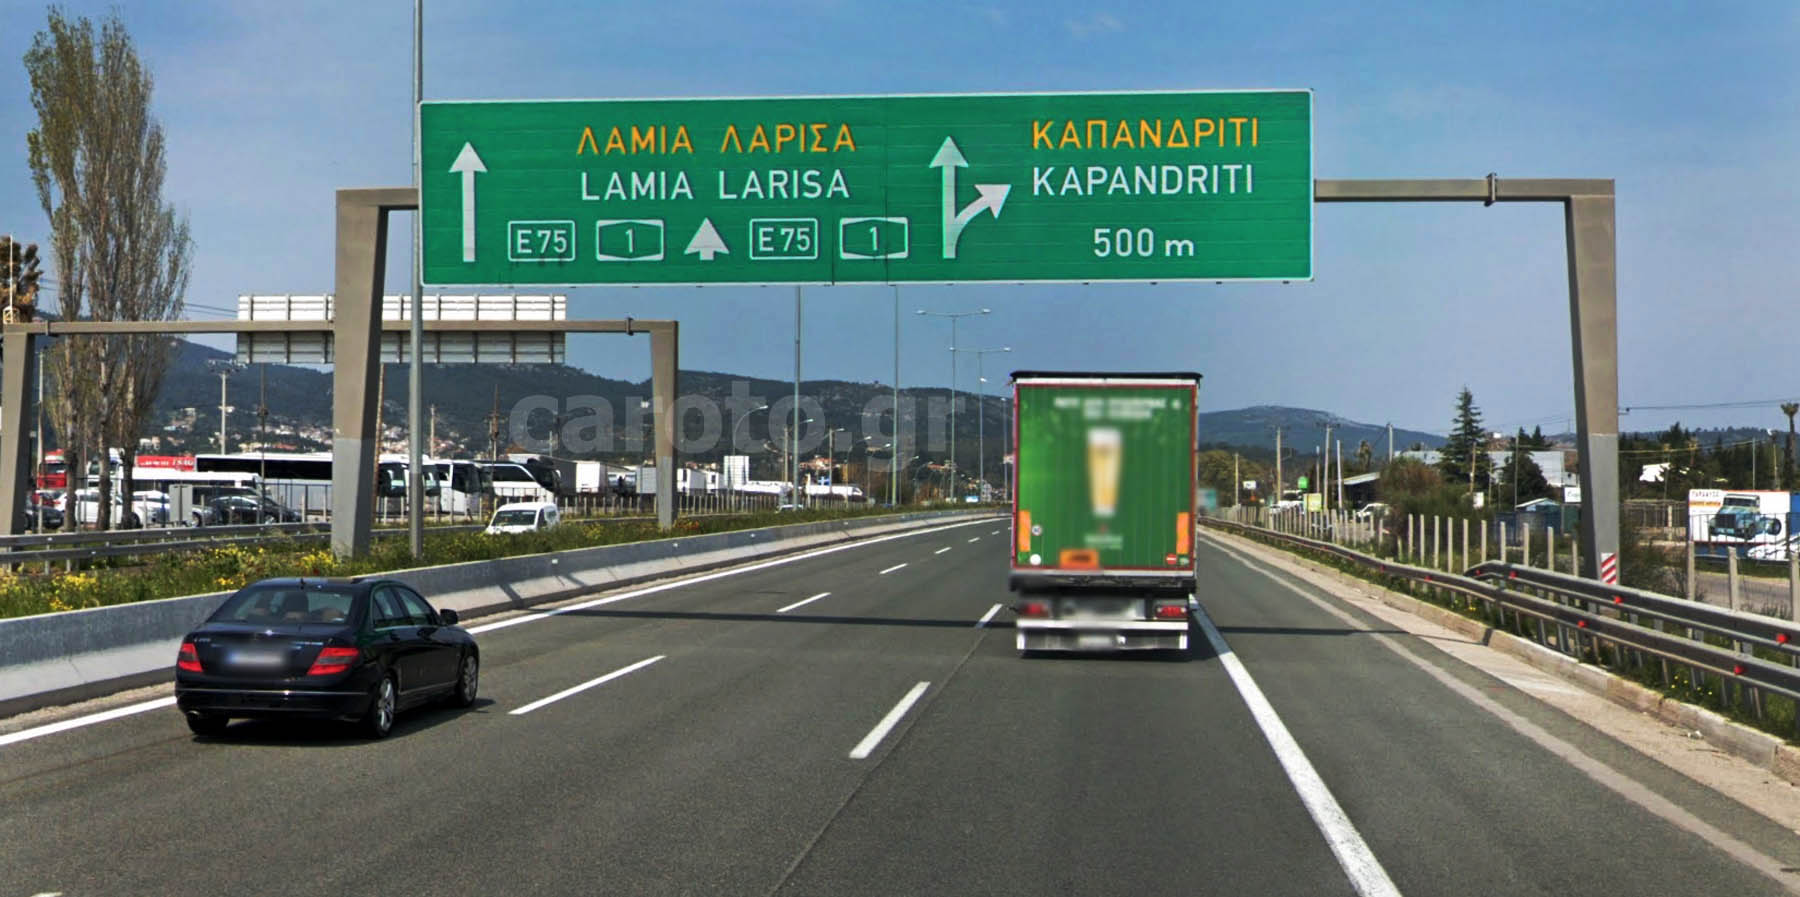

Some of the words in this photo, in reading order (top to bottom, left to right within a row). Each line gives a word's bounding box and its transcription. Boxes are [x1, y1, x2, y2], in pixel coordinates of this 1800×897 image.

[577, 125, 694, 155] ΛΑΜΙΑ
[720, 123, 857, 153] ΛΑΡΙΣΑ
[1031, 117, 1259, 149] ΚΑΠΑΝΔΡΙΤΙ
[581, 171, 694, 200] LAMIA
[719, 169, 850, 199] LARISA
[1032, 164, 1253, 195] KAPANDRITI
[624, 229, 634, 253] 1
[869, 227, 878, 251] 1
[1093, 228, 1154, 257] 500
[1165, 239, 1195, 256] m
